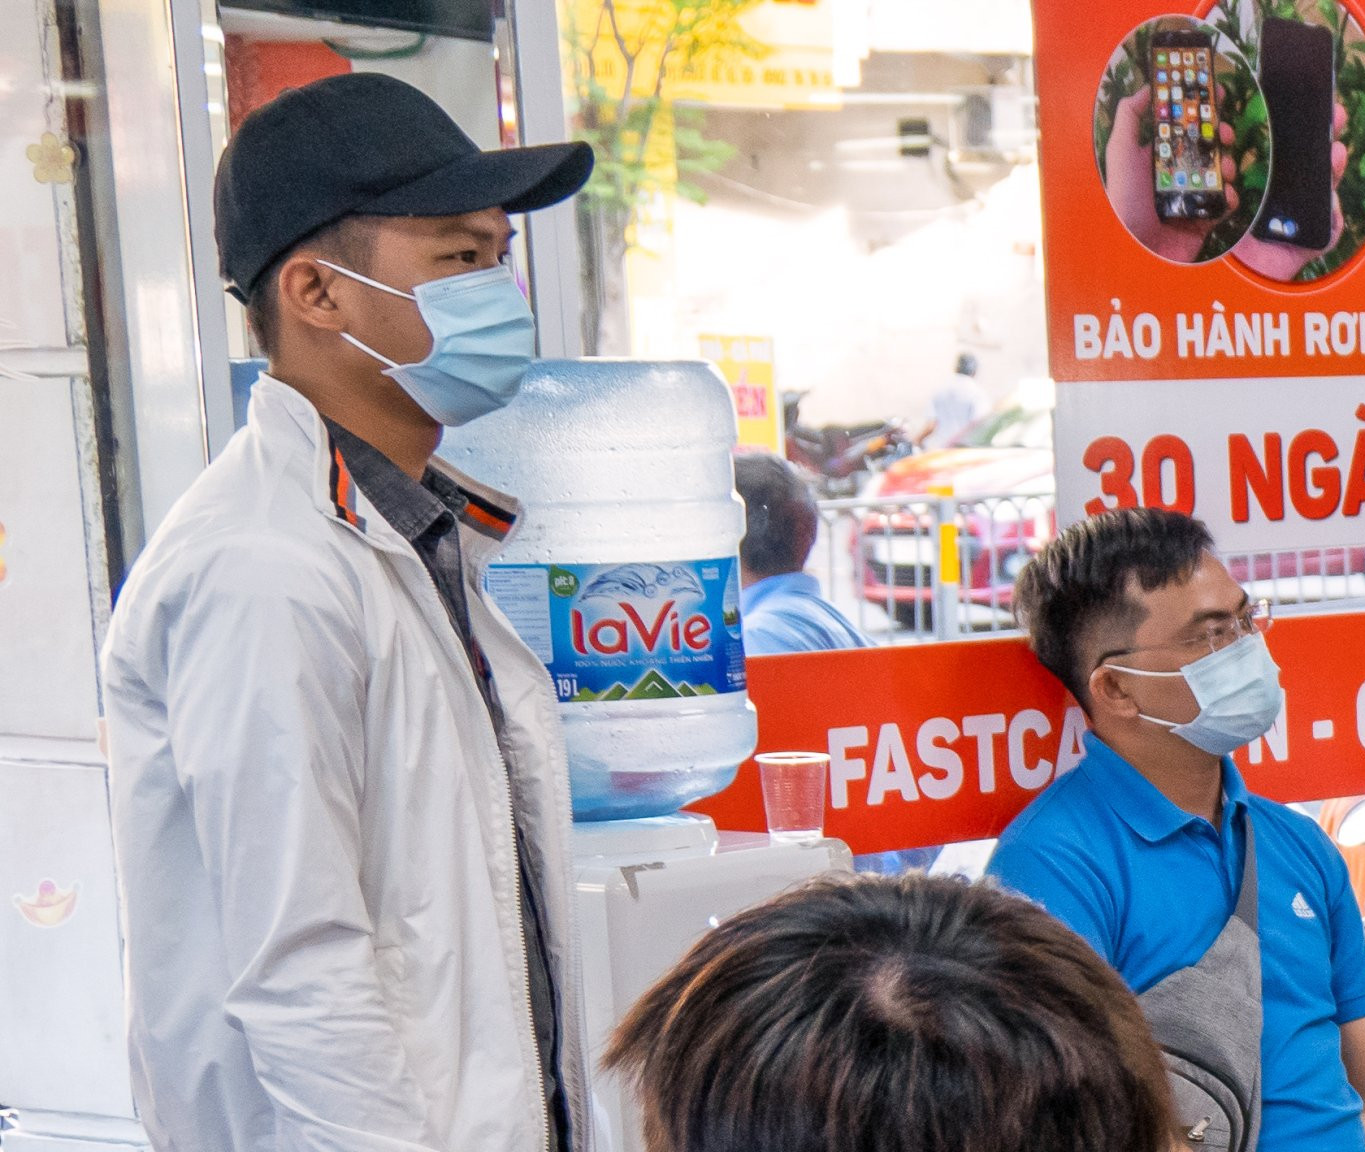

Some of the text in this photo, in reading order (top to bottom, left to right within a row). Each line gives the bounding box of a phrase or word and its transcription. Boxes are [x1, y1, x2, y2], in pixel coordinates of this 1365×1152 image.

[1074, 299, 1160, 360] BẢO
[1177, 301, 1289, 357] HÀNH
[1084, 435, 1194, 516] 30
